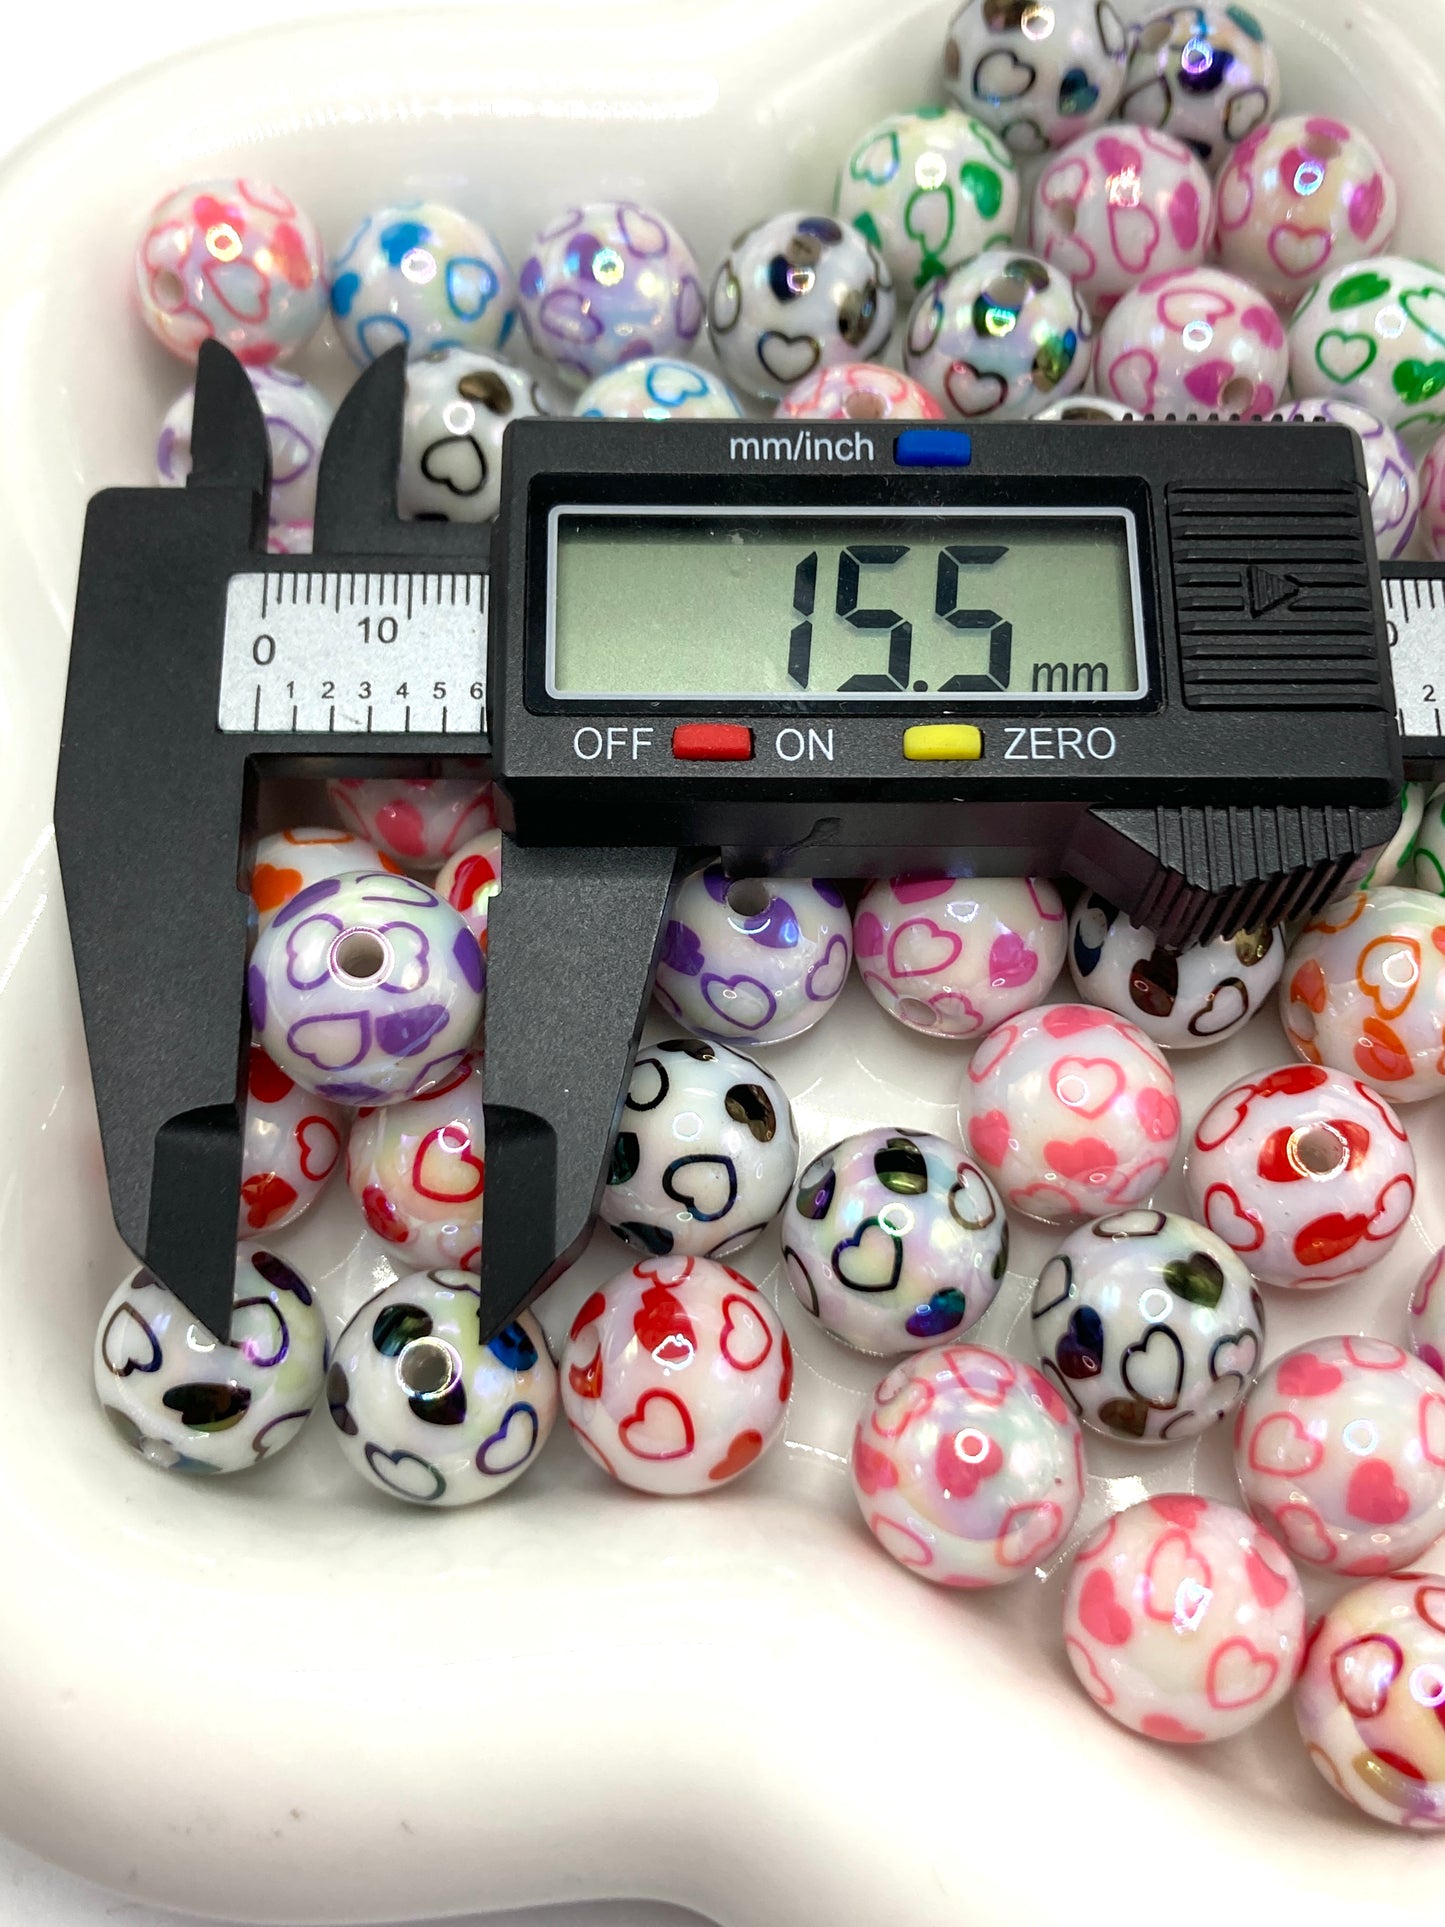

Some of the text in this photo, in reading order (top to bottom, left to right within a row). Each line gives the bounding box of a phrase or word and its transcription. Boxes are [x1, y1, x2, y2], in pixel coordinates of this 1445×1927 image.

[729, 431, 875, 463] mm/inch
[787, 545, 1109, 692] 15.5 mm
[252, 616, 399, 665] 0 10
[286, 680, 484, 700] 1 2 3 4 5 6
[1422, 684, 1437, 702] 2
[573, 726, 655, 762] OFF
[775, 726, 835, 762] ON
[1003, 726, 1117, 762] ZERO
